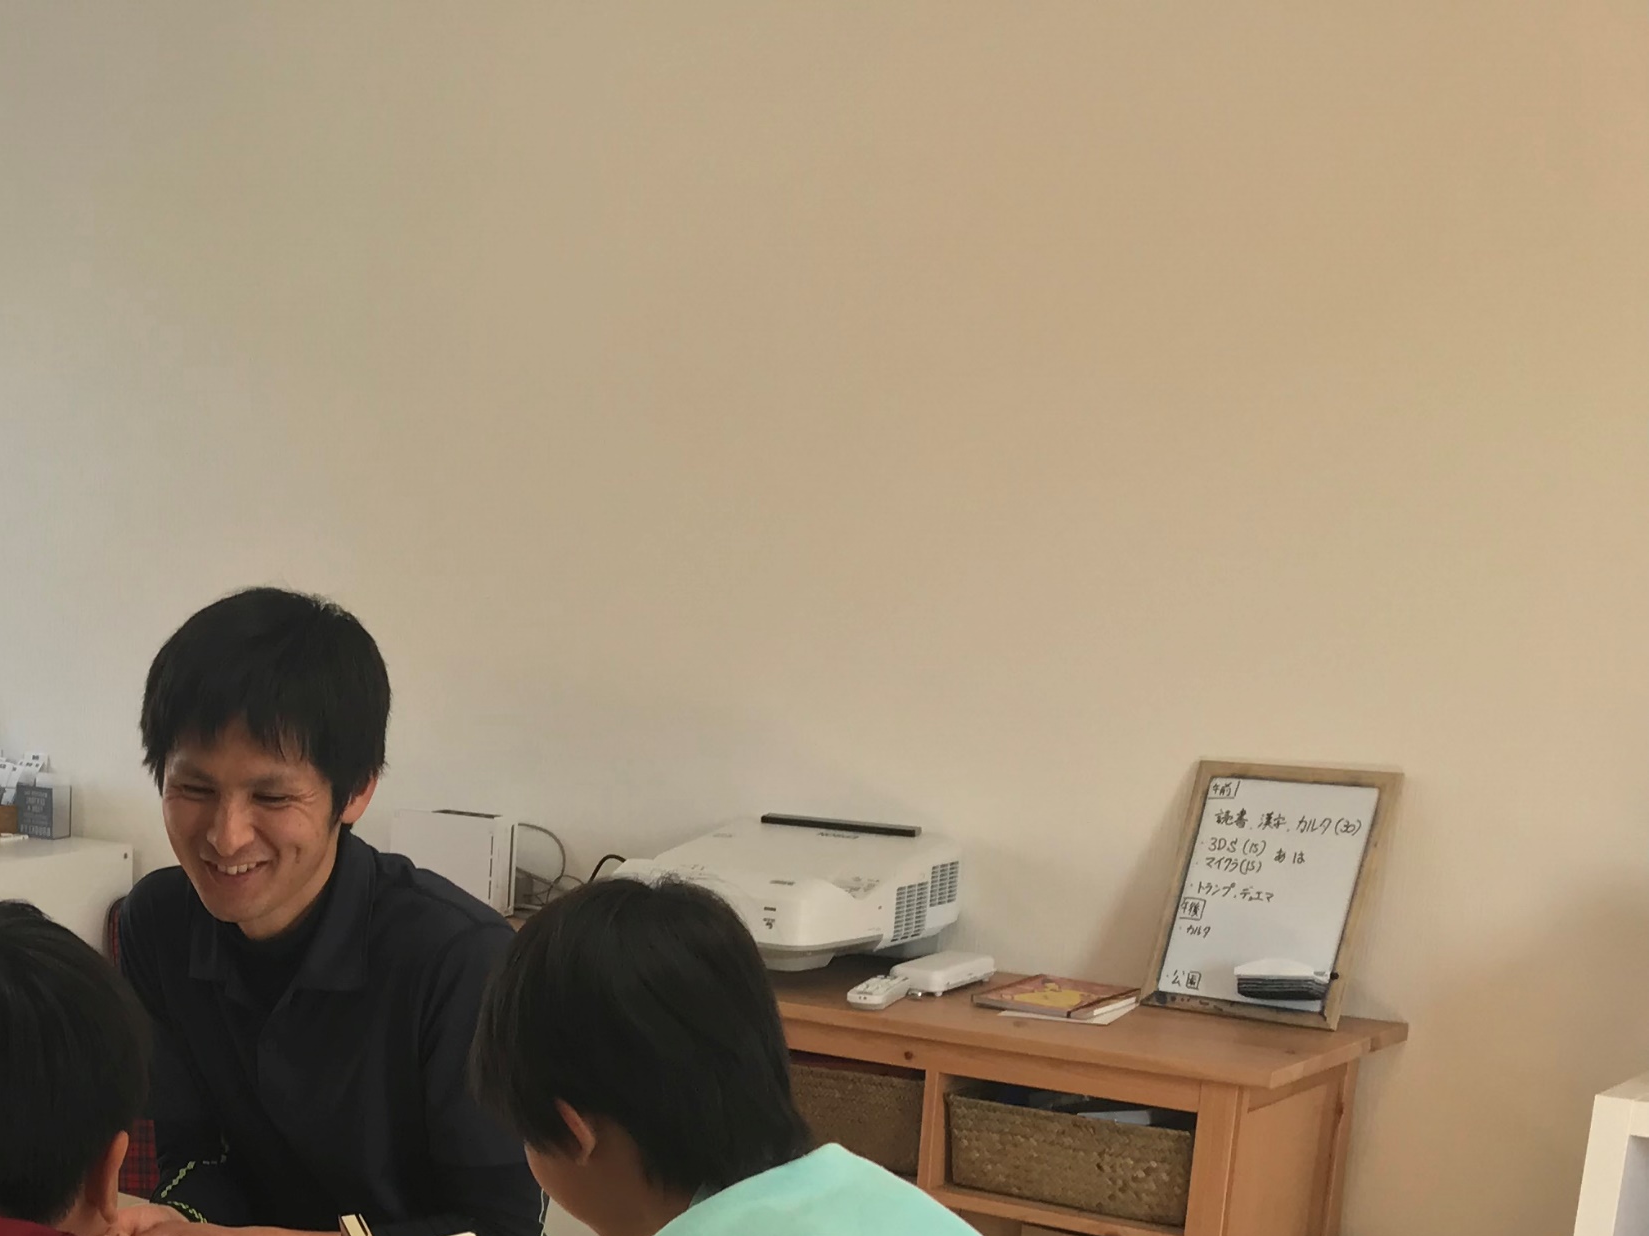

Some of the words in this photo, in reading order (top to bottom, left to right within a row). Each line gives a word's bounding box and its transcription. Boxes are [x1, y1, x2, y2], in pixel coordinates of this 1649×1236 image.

[1211, 781, 1232, 797] 午前
[1180, 900, 1200, 917] 午後
[1186, 924, 1211, 938] カルタ
